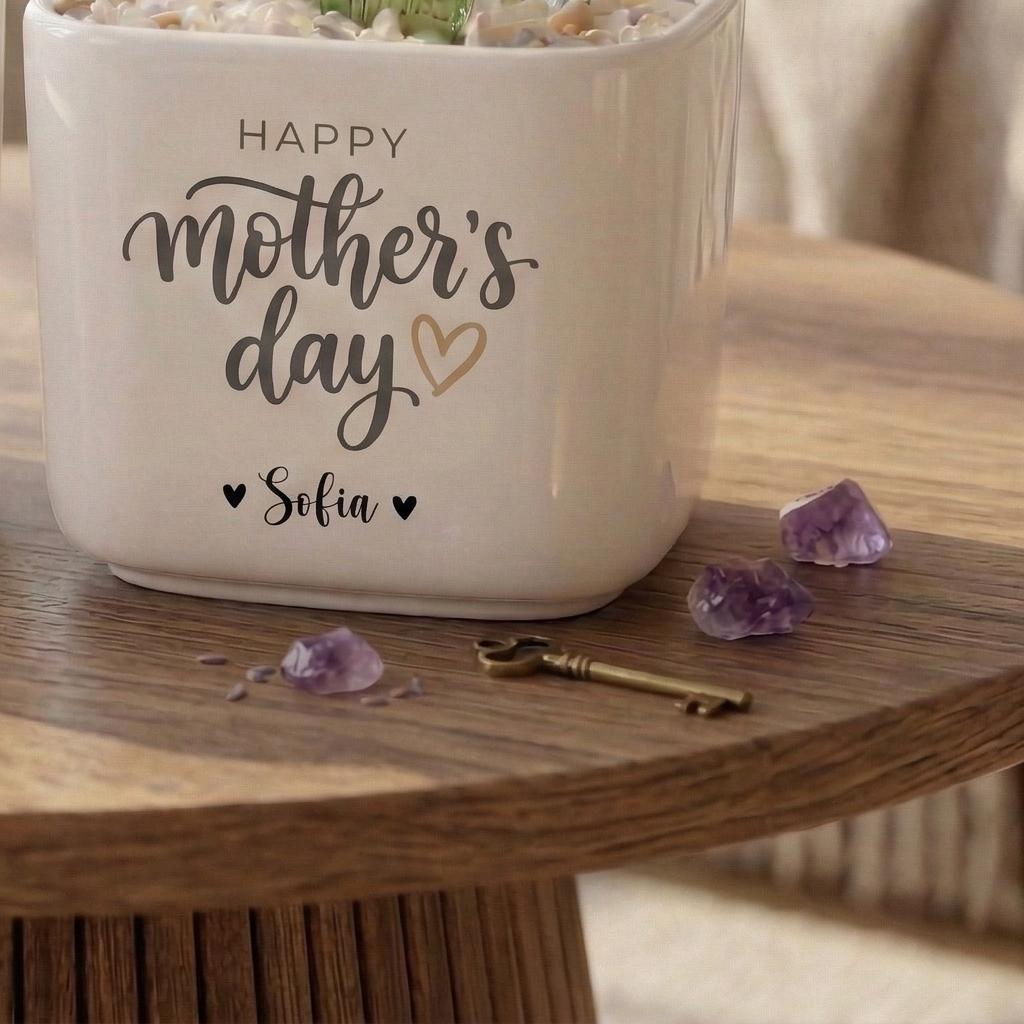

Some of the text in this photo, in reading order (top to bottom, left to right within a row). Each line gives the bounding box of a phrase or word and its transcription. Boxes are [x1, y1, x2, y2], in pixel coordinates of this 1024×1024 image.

[240, 119, 407, 158] HAPPY
[226, 285, 419, 451] day
[258, 466, 379, 527] Sofia
